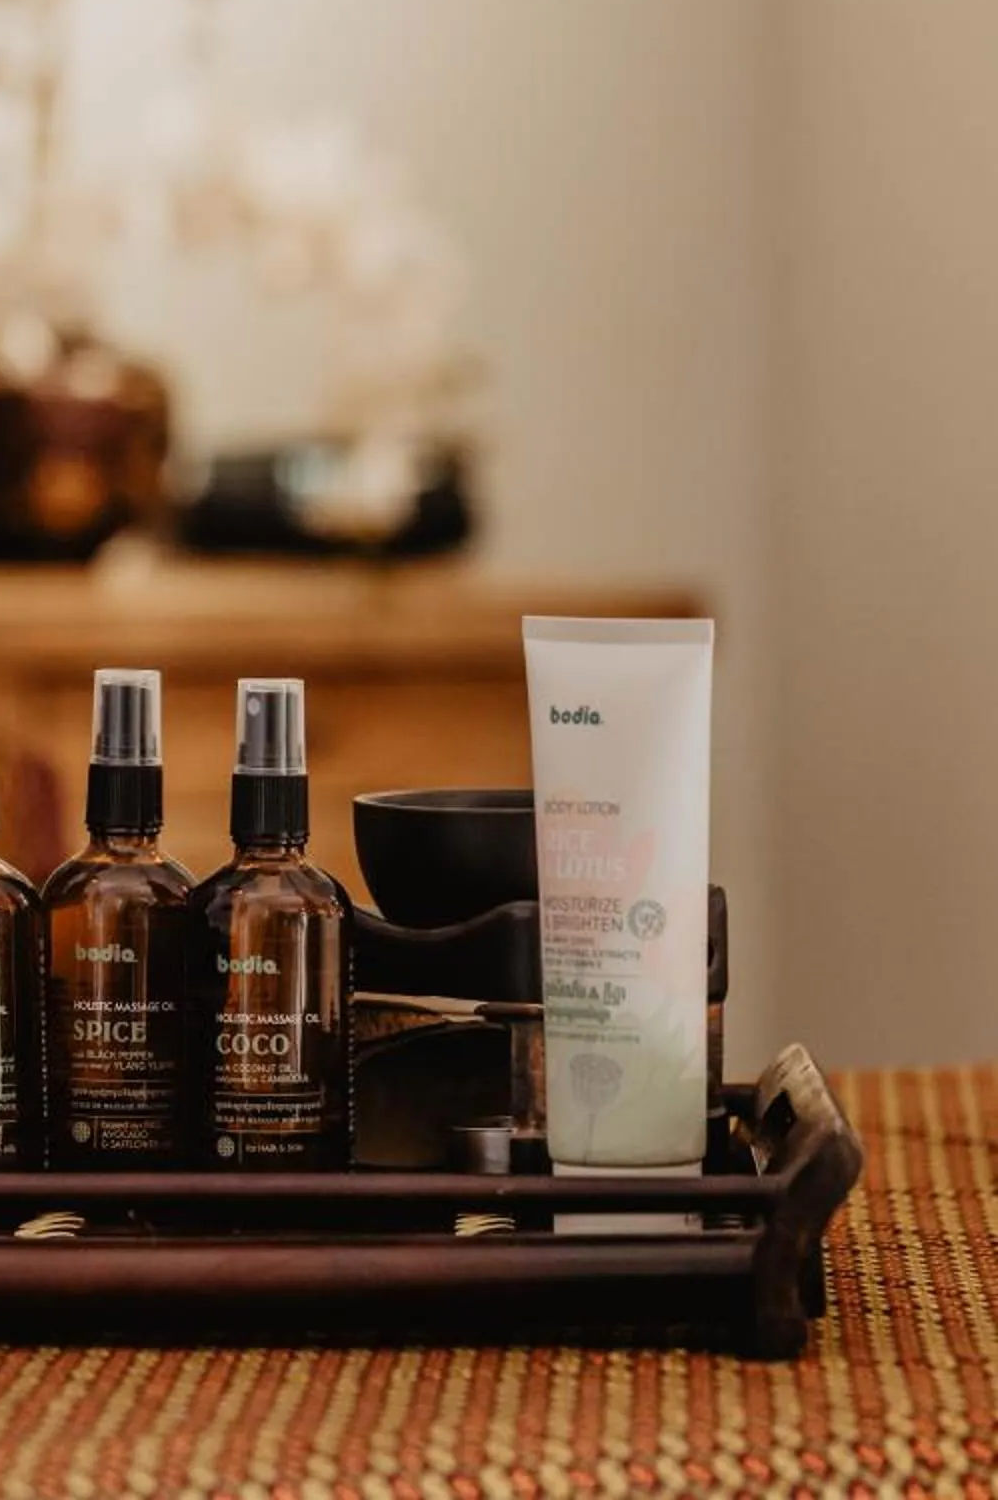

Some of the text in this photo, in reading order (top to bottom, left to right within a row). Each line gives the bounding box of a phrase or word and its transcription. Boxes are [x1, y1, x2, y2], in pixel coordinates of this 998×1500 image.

[577, 801, 620, 816] LOTION
[73, 1001, 175, 1013] HOLISTIC MASSAGE OIL
[305, 1013, 321, 1023] OIL
[73, 1019, 147, 1043] SPICE
[216, 1032, 290, 1055] COCO
